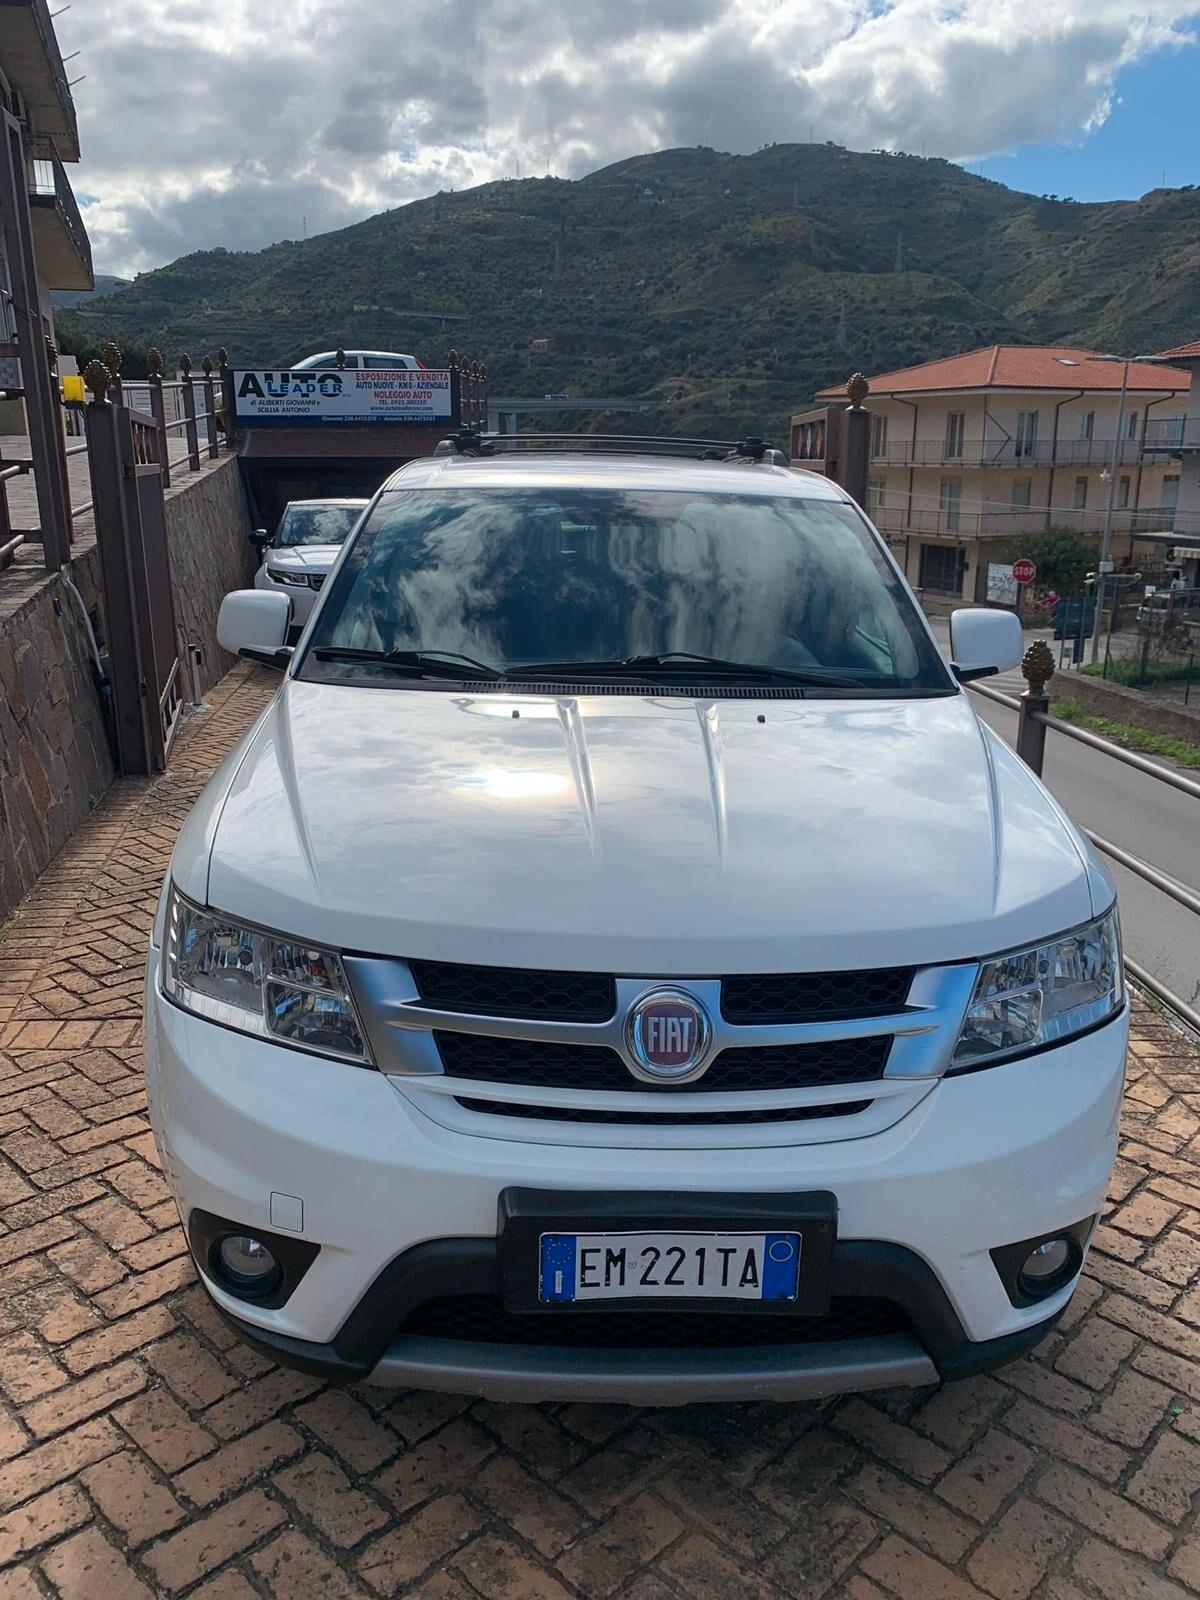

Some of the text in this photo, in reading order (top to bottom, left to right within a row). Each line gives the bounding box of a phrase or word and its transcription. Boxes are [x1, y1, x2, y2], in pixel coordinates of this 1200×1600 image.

[355, 372, 448, 381] ESPOSIZIONE E VENDITA
[238, 373, 343, 398] AUTO
[267, 381, 343, 393] LEADER
[355, 382, 374, 390] AUTO
[374, 382, 394, 390] NUOVE
[416, 382, 449, 390] AZIENDALE
[374, 391, 432, 399] NOLEGGIO AUTO
[1015, 567, 1034, 576] STOP
[647, 1016, 693, 1054] FIAT
